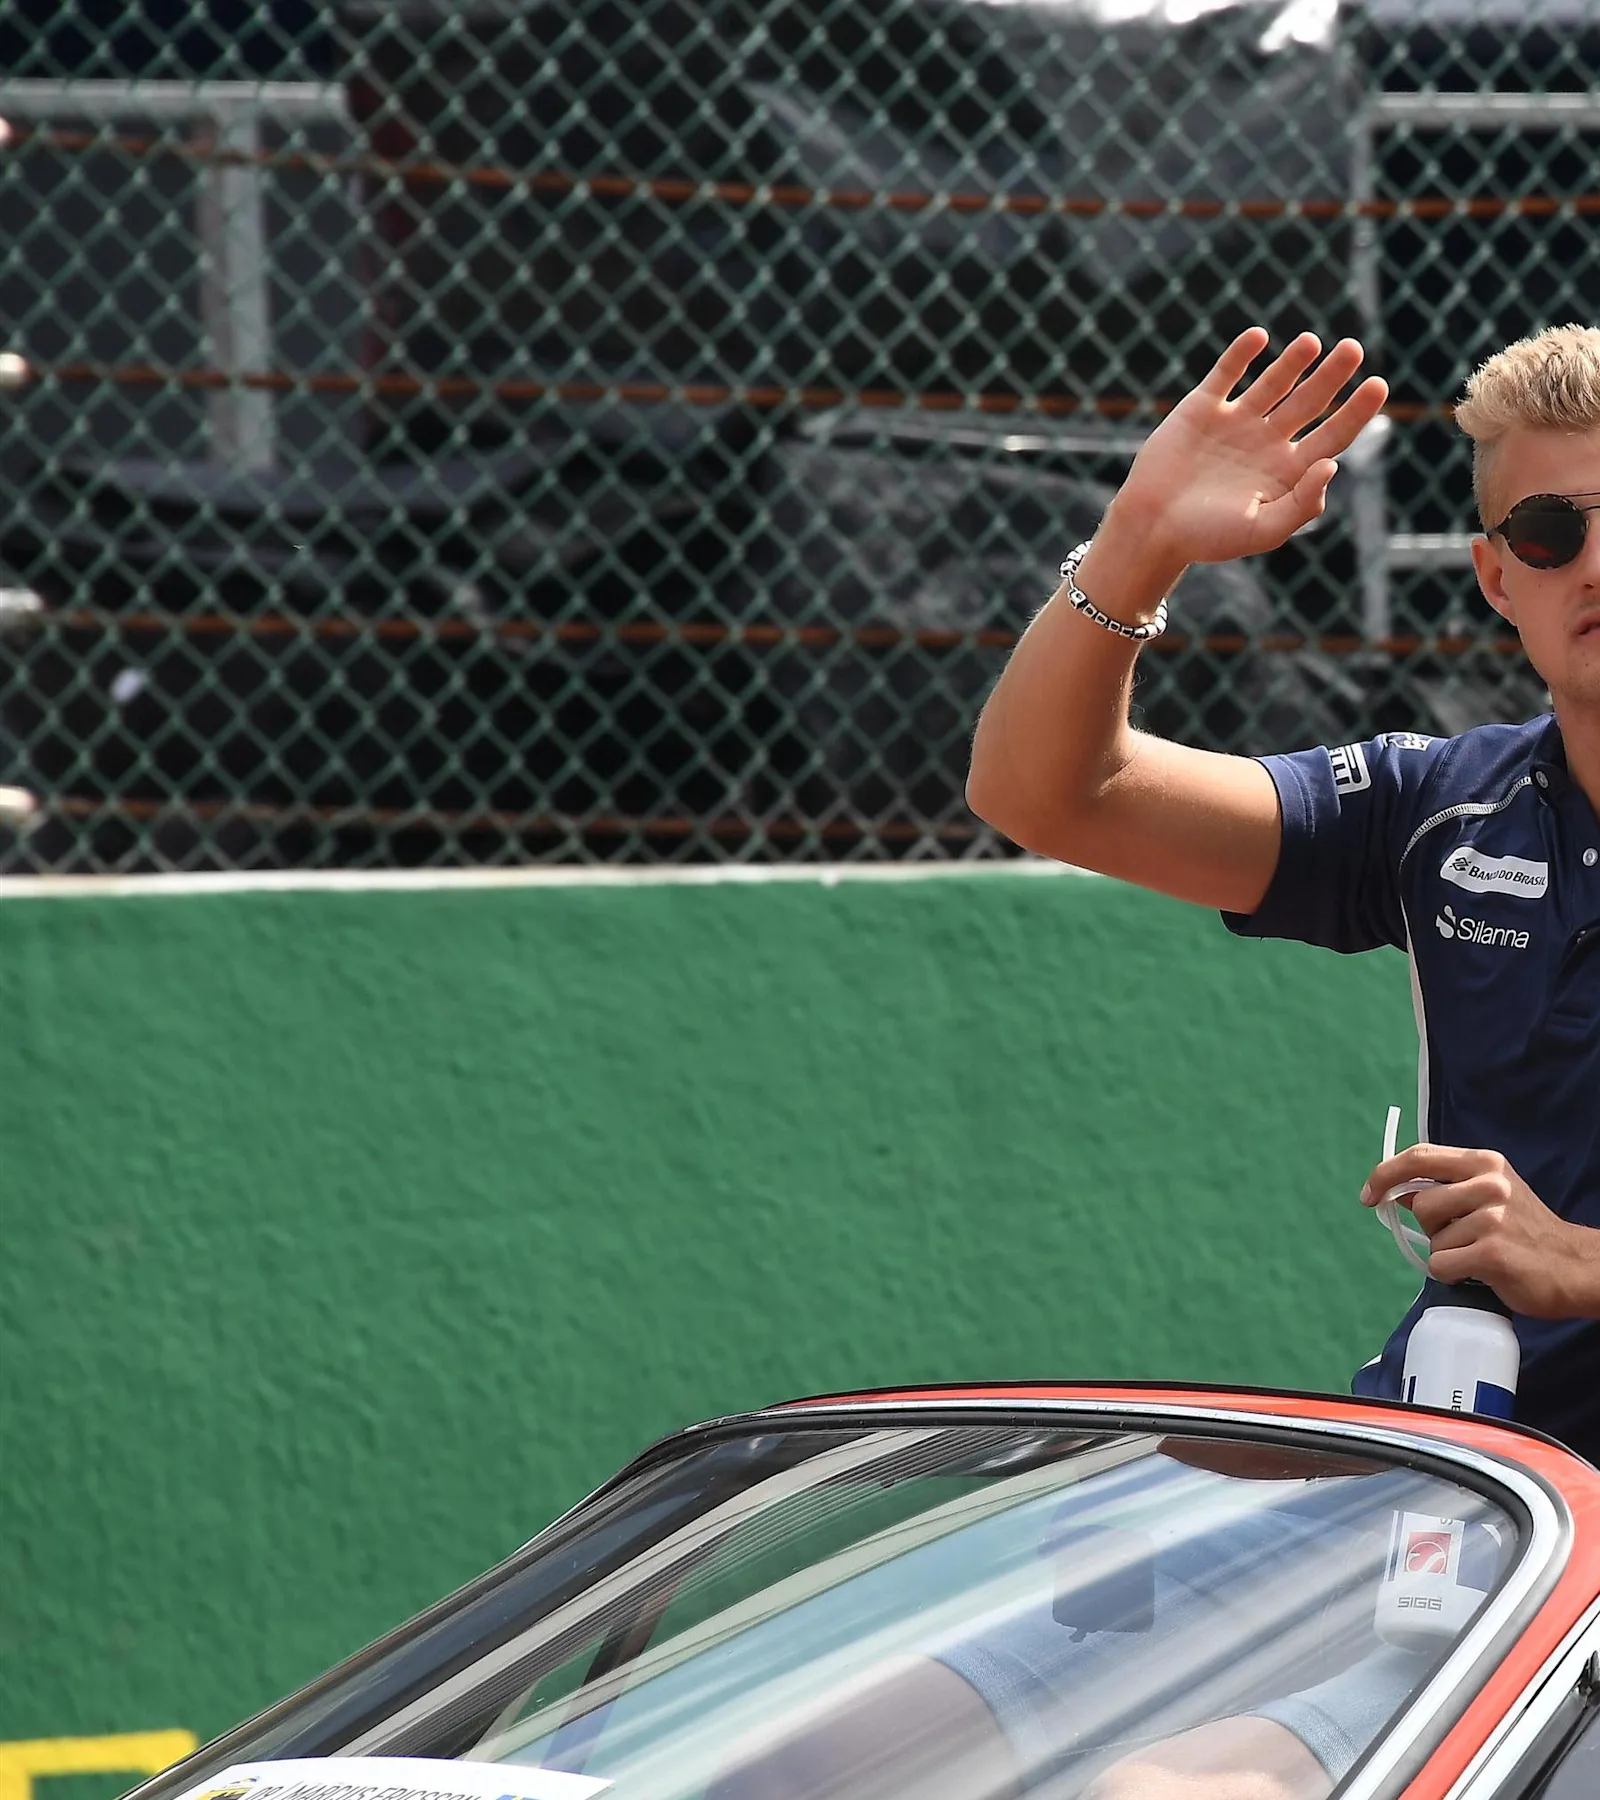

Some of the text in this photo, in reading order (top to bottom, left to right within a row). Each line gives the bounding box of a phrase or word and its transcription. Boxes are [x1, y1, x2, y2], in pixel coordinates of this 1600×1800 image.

[1498, 870, 1513, 880] DO
[1513, 871, 1546, 886] BRASIL
[1456, 918, 1530, 949] Silanna
[1398, 1597, 1442, 1611] SIGG
[281, 1785, 378, 1800] MARCUS
